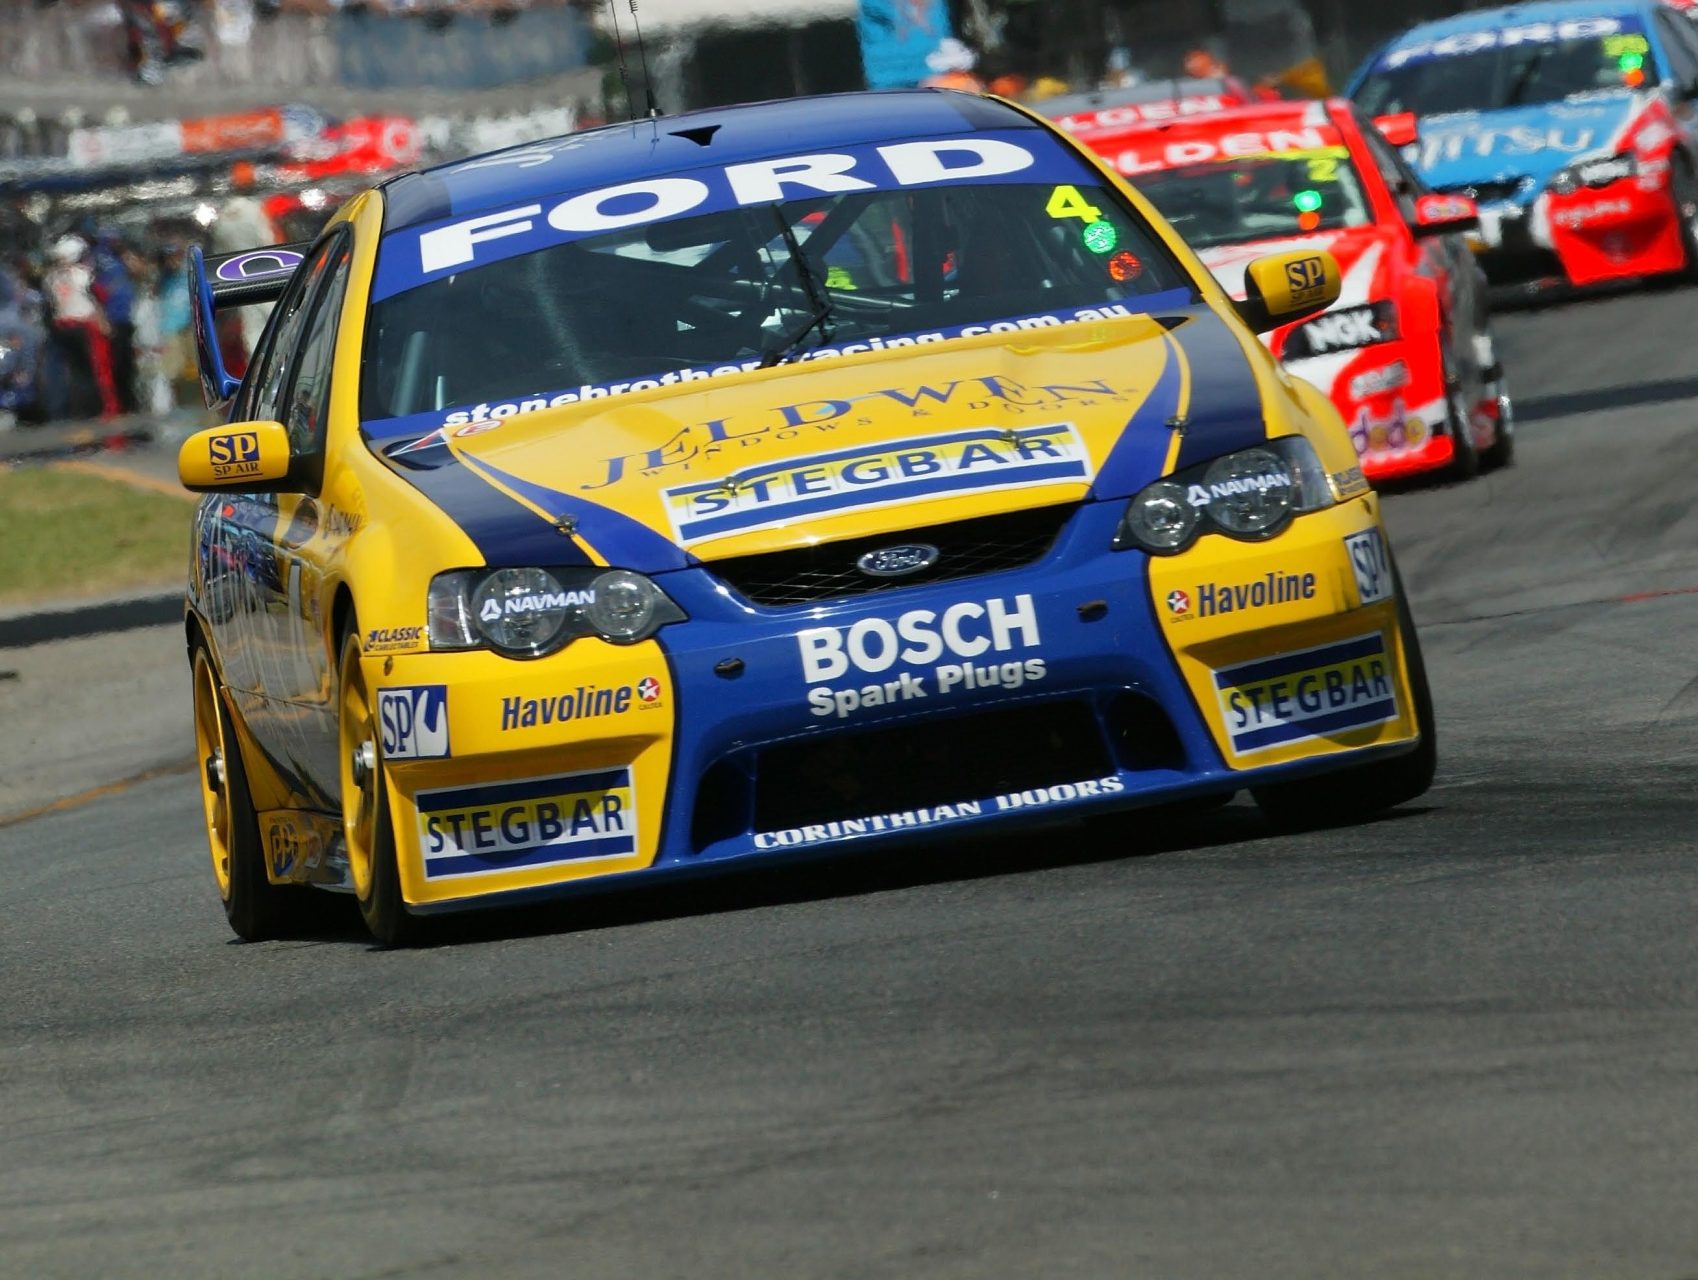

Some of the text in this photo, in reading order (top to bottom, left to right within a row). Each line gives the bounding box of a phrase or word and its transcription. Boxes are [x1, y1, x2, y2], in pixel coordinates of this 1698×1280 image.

[1100, 126, 1324, 175] LDEN
[419, 139, 1035, 274] FORD
[1045, 185, 1102, 223] 4
[1288, 259, 1322, 290] SP
[1303, 308, 1381, 353] NGK
[210, 434, 257, 465] SP
[214, 462, 260, 476] SP AIR
[693, 437, 1062, 516] STEGBAR
[1210, 472, 1292, 498] NAVMAN
[504, 589, 597, 614] NAVMAN
[1195, 571, 1317, 618] Havoline
[378, 626, 423, 642] CLASSIC
[797, 593, 1041, 684] BOSCH
[501, 685, 633, 731] Havoline
[807, 658, 1048, 718] Spark Plugs
[1229, 660, 1390, 729] STEGBAR
[381, 694, 413, 754] SP
[427, 794, 625, 853] STEGBAR
[754, 776, 1125, 849] CORINTHIAN DOORS
